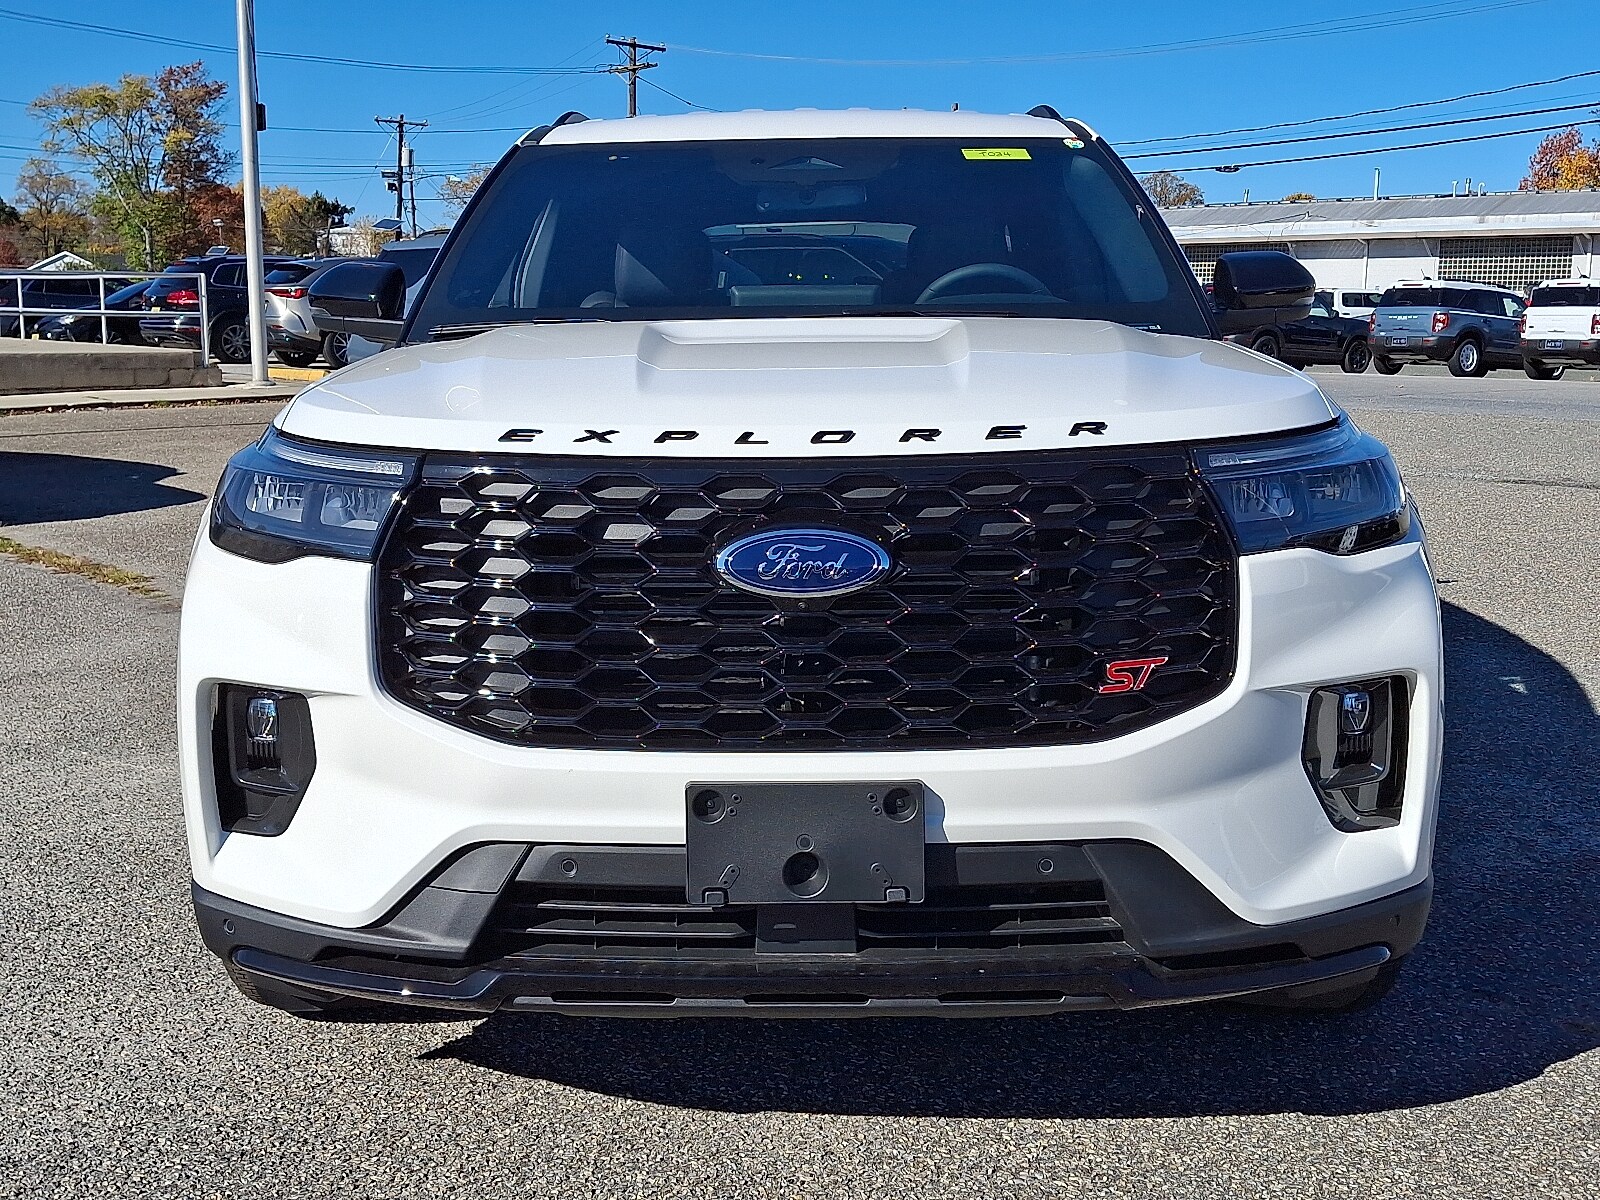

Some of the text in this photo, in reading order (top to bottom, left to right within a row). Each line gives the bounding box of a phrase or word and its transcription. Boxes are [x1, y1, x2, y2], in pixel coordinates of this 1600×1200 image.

[498, 421, 1108, 444] EXPLORER
[758, 543, 848, 580] Ford
[1099, 657, 1168, 693] ST
